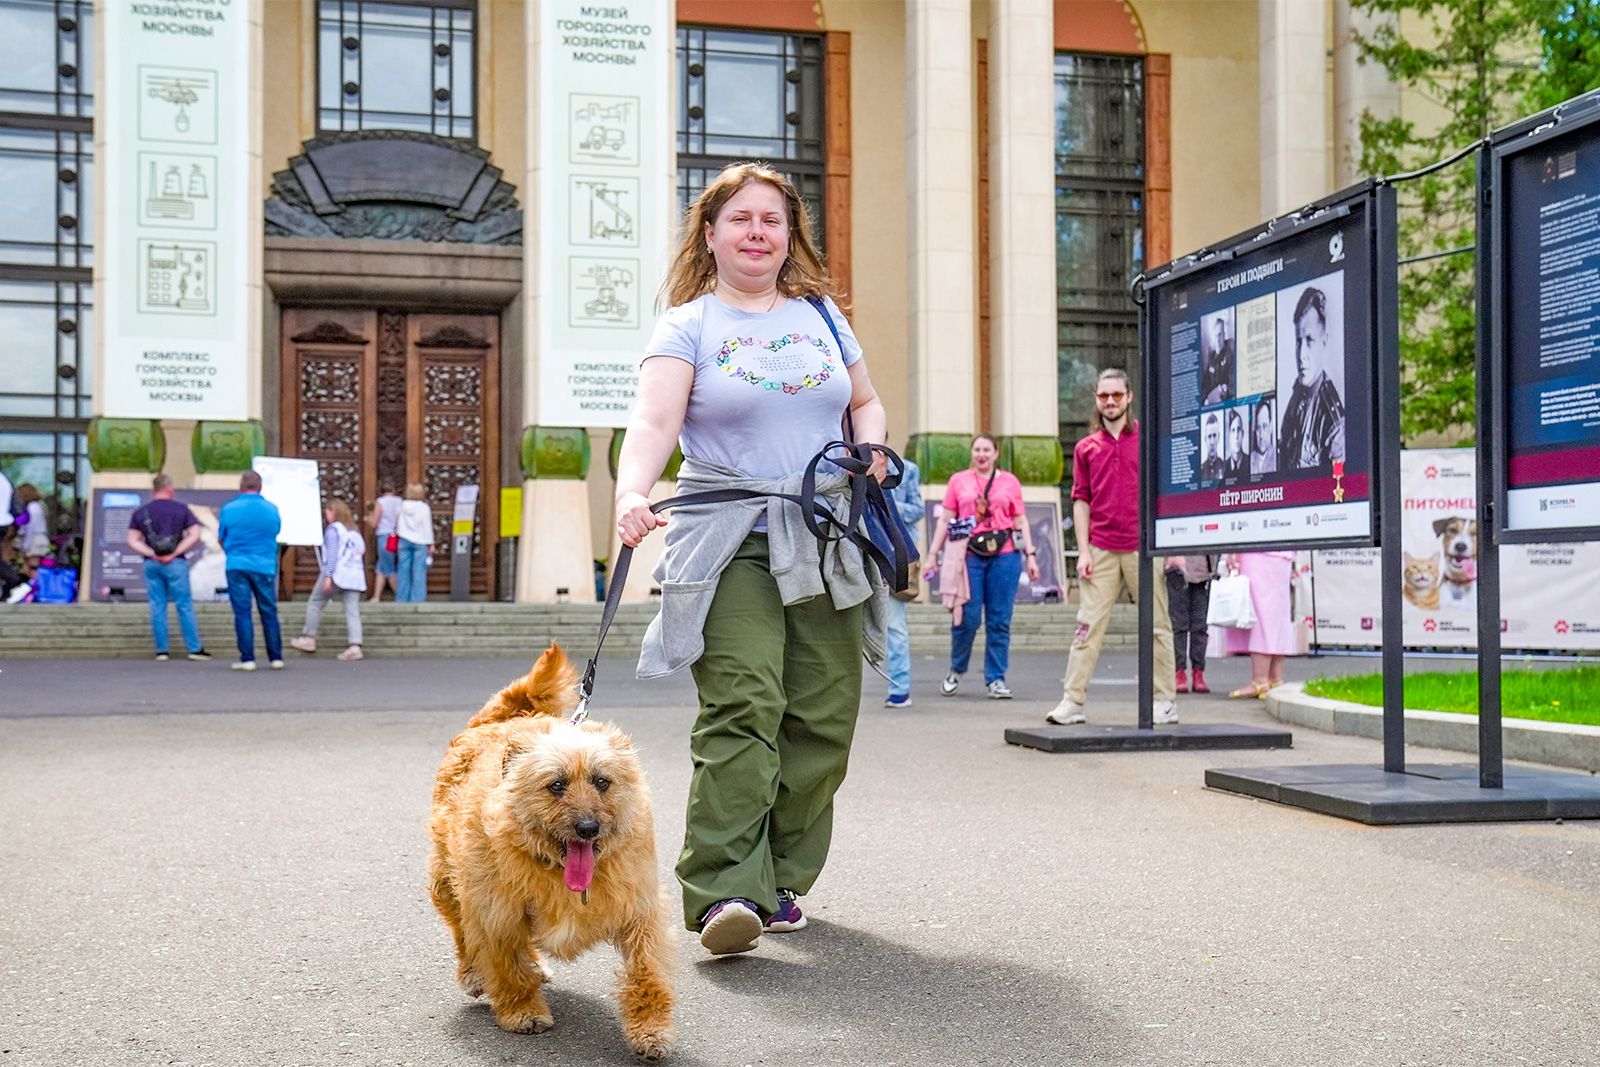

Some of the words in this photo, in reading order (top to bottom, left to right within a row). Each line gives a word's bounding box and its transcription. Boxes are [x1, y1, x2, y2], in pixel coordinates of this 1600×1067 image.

[130, 4, 226, 21] ХОЗЯЙСТВА
[580, 6, 629, 19] МУЗЕЙ
[142, 21, 214, 37] МОСКВЫ
[556, 19, 652, 36] ГОРОДСКОГО
[562, 34, 647, 50] ХОЗЯЙСТВА
[572, 51, 636, 65] МОСКВЫ
[1217, 273, 1240, 293] ГЕРОИ
[1240, 270, 1247, 286] И
[1247, 257, 1284, 282] ПОДВИГИ
[143, 351, 210, 362] КОМПЛЕКС
[135, 363, 217, 376] ГОРОДСКОГО
[574, 363, 635, 373] КОМПЛЕКС
[141, 377, 212, 389] ХОЗЯЙСТВА
[567, 375, 640, 387] ГОРОДСКОГО
[149, 392, 204, 402] МОСКВЫ
[573, 387, 636, 399] ХОЗЯЙСТВА
[579, 401, 629, 411] МОСКВЫ
[1219, 489, 1240, 507] ПЁТР
[1240, 486, 1284, 504] ШИРОНИН
